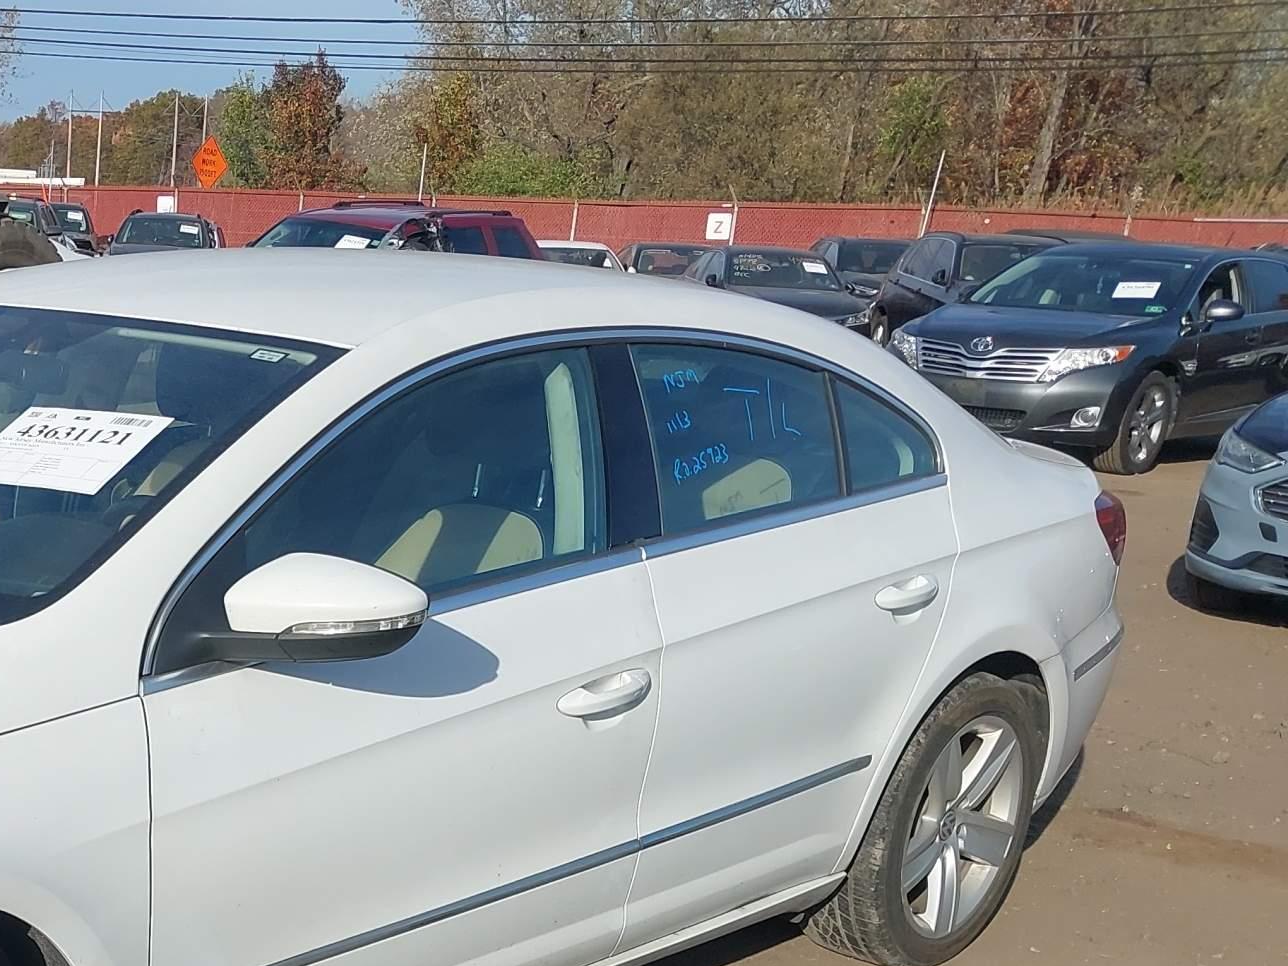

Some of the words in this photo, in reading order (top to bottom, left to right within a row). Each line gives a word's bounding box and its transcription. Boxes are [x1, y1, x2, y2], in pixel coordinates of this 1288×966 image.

[203, 147, 218, 156] ROAD
[713, 220, 724, 234] Z
[664, 368, 700, 394] NJM
[17, 423, 133, 445] 43631121
